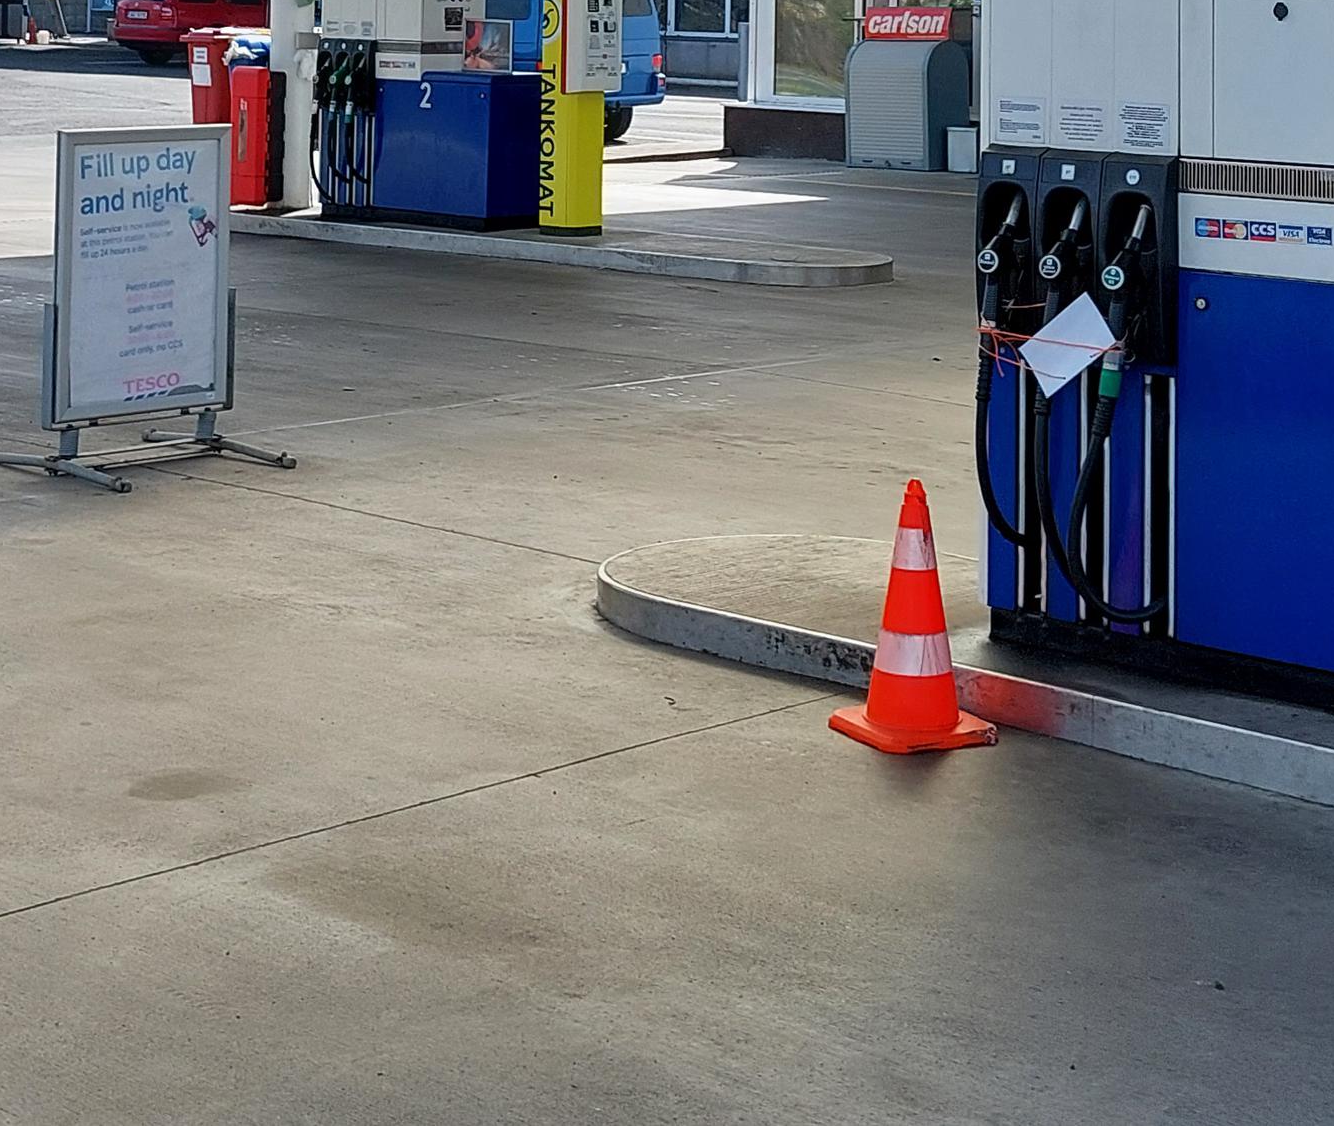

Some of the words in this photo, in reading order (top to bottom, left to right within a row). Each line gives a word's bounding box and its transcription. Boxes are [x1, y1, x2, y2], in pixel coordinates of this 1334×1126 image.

[868, 11, 945, 34] carlson
[419, 81, 432, 109] 2
[539, 64, 556, 217] TANKOMAT
[80, 152, 114, 179] Fill
[122, 155, 150, 179] up
[156, 147, 196, 174] day
[80, 187, 124, 215] and
[1251, 224, 1275, 236] CCS
[1282, 230, 1299, 238] VISA
[100, 248, 108, 257] 24
[123, 372, 180, 394] TESCO
